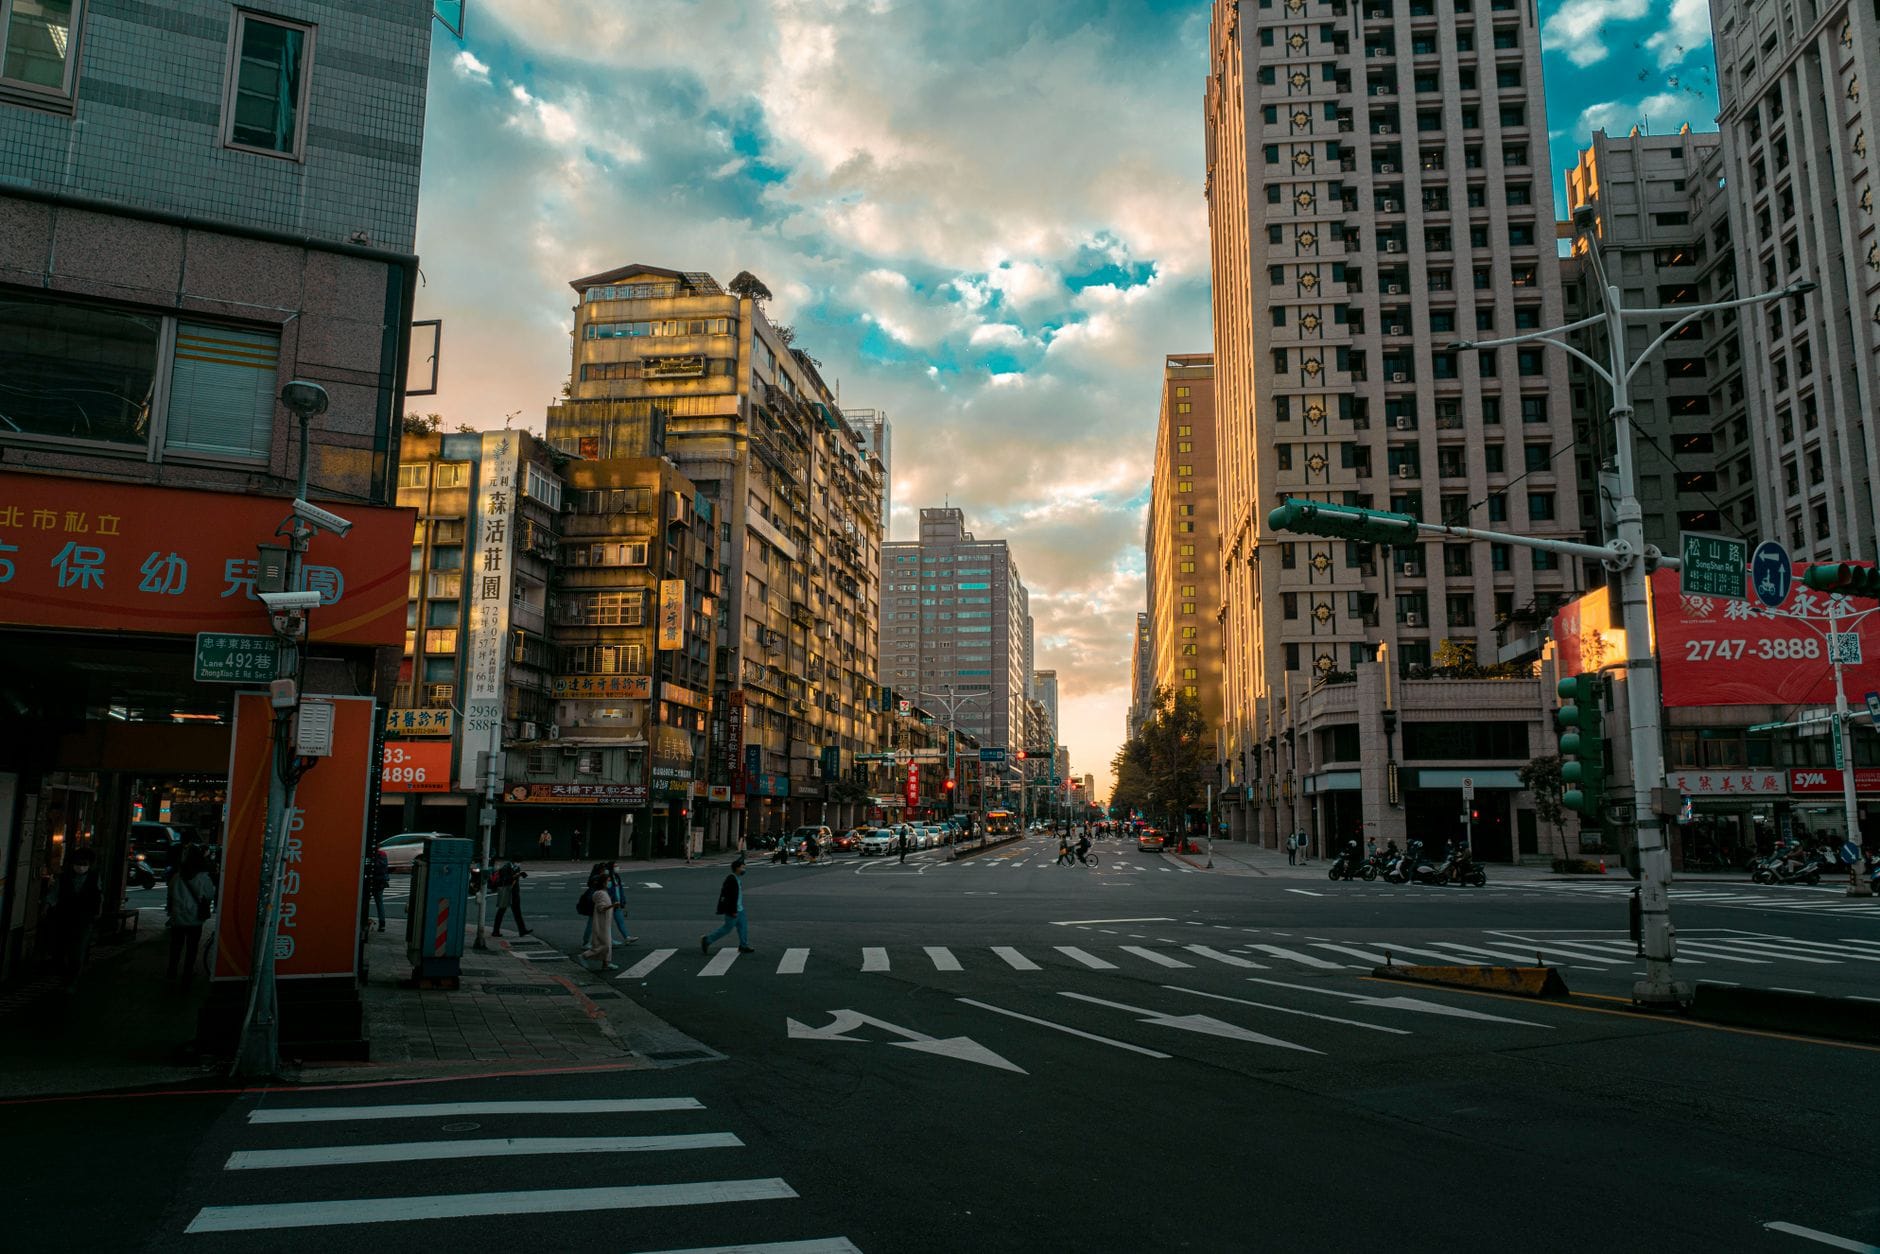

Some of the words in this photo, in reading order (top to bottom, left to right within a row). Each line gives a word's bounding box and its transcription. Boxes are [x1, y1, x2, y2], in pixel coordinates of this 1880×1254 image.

[481, 491, 507, 601] 森活莊園
[1688, 537, 1740, 562] 松山路
[1685, 638, 1821, 662] 2747-3888
[203, 659, 225, 668] Lane
[388, 710, 449, 728] 牙醫診所
[470, 705, 498, 718] 2936
[382, 767, 426, 783] 4896
[1794, 771, 1828, 789] SYM
